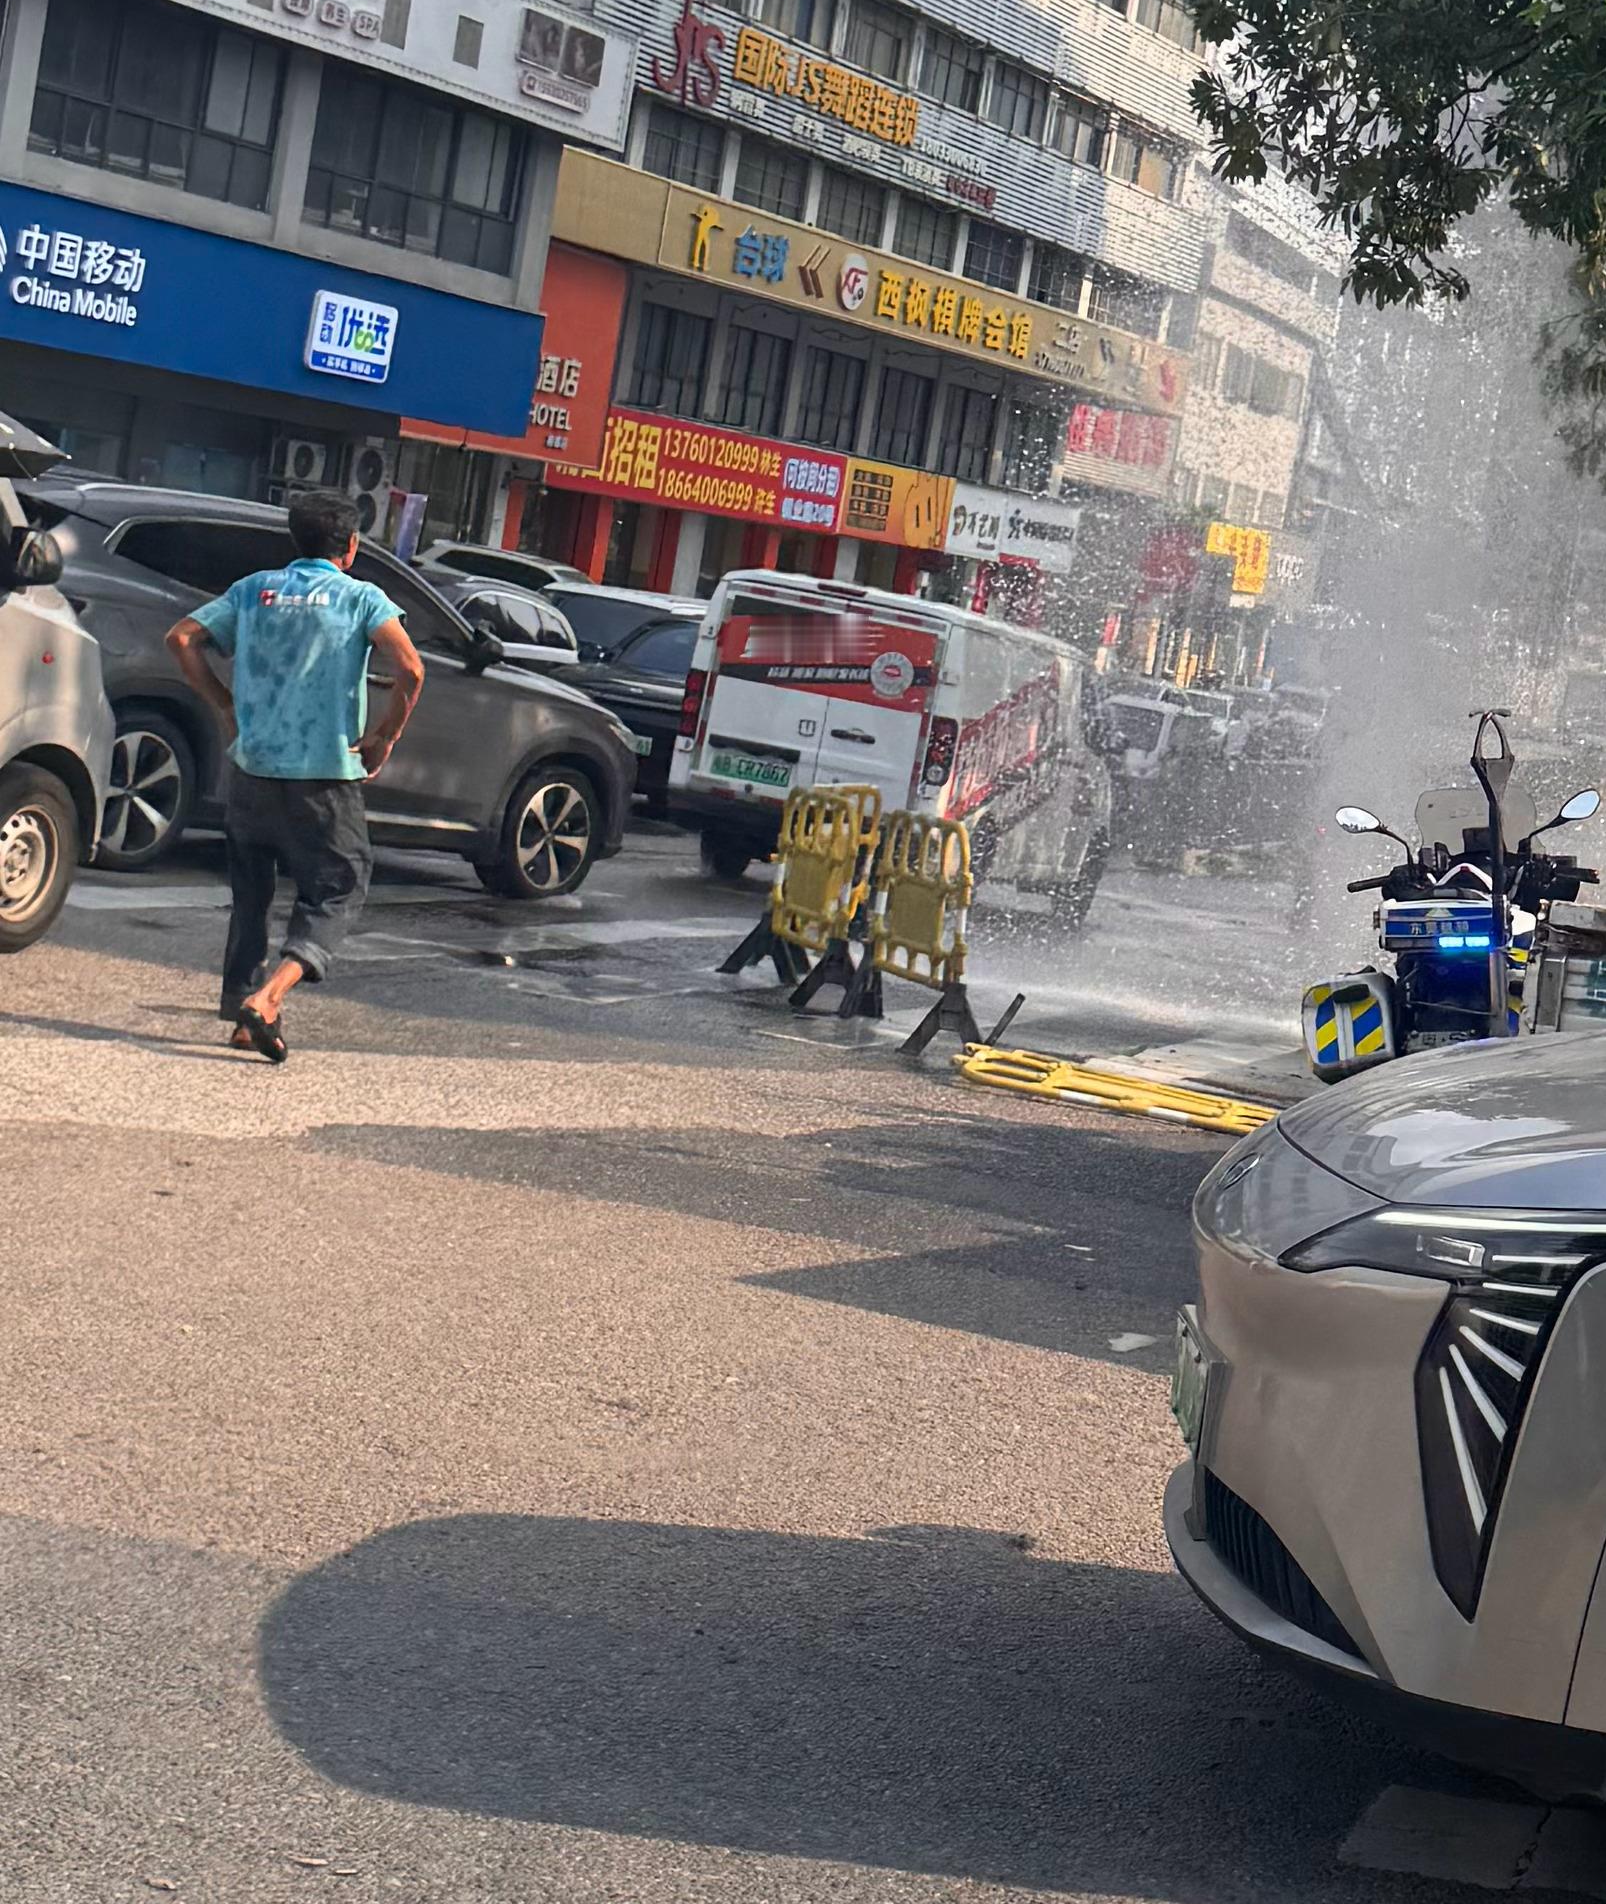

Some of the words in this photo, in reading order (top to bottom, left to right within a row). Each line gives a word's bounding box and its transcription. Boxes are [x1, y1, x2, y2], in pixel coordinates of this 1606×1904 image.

[358, 15, 381, 34] SPA
[16, 224, 147, 293] 中国移动
[733, 224, 790, 284] 台球
[10, 276, 71, 313] China
[71, 288, 138, 327] Mobile
[664, 427, 759, 474] 13760120999
[657, 468, 754, 512] 18664006999
